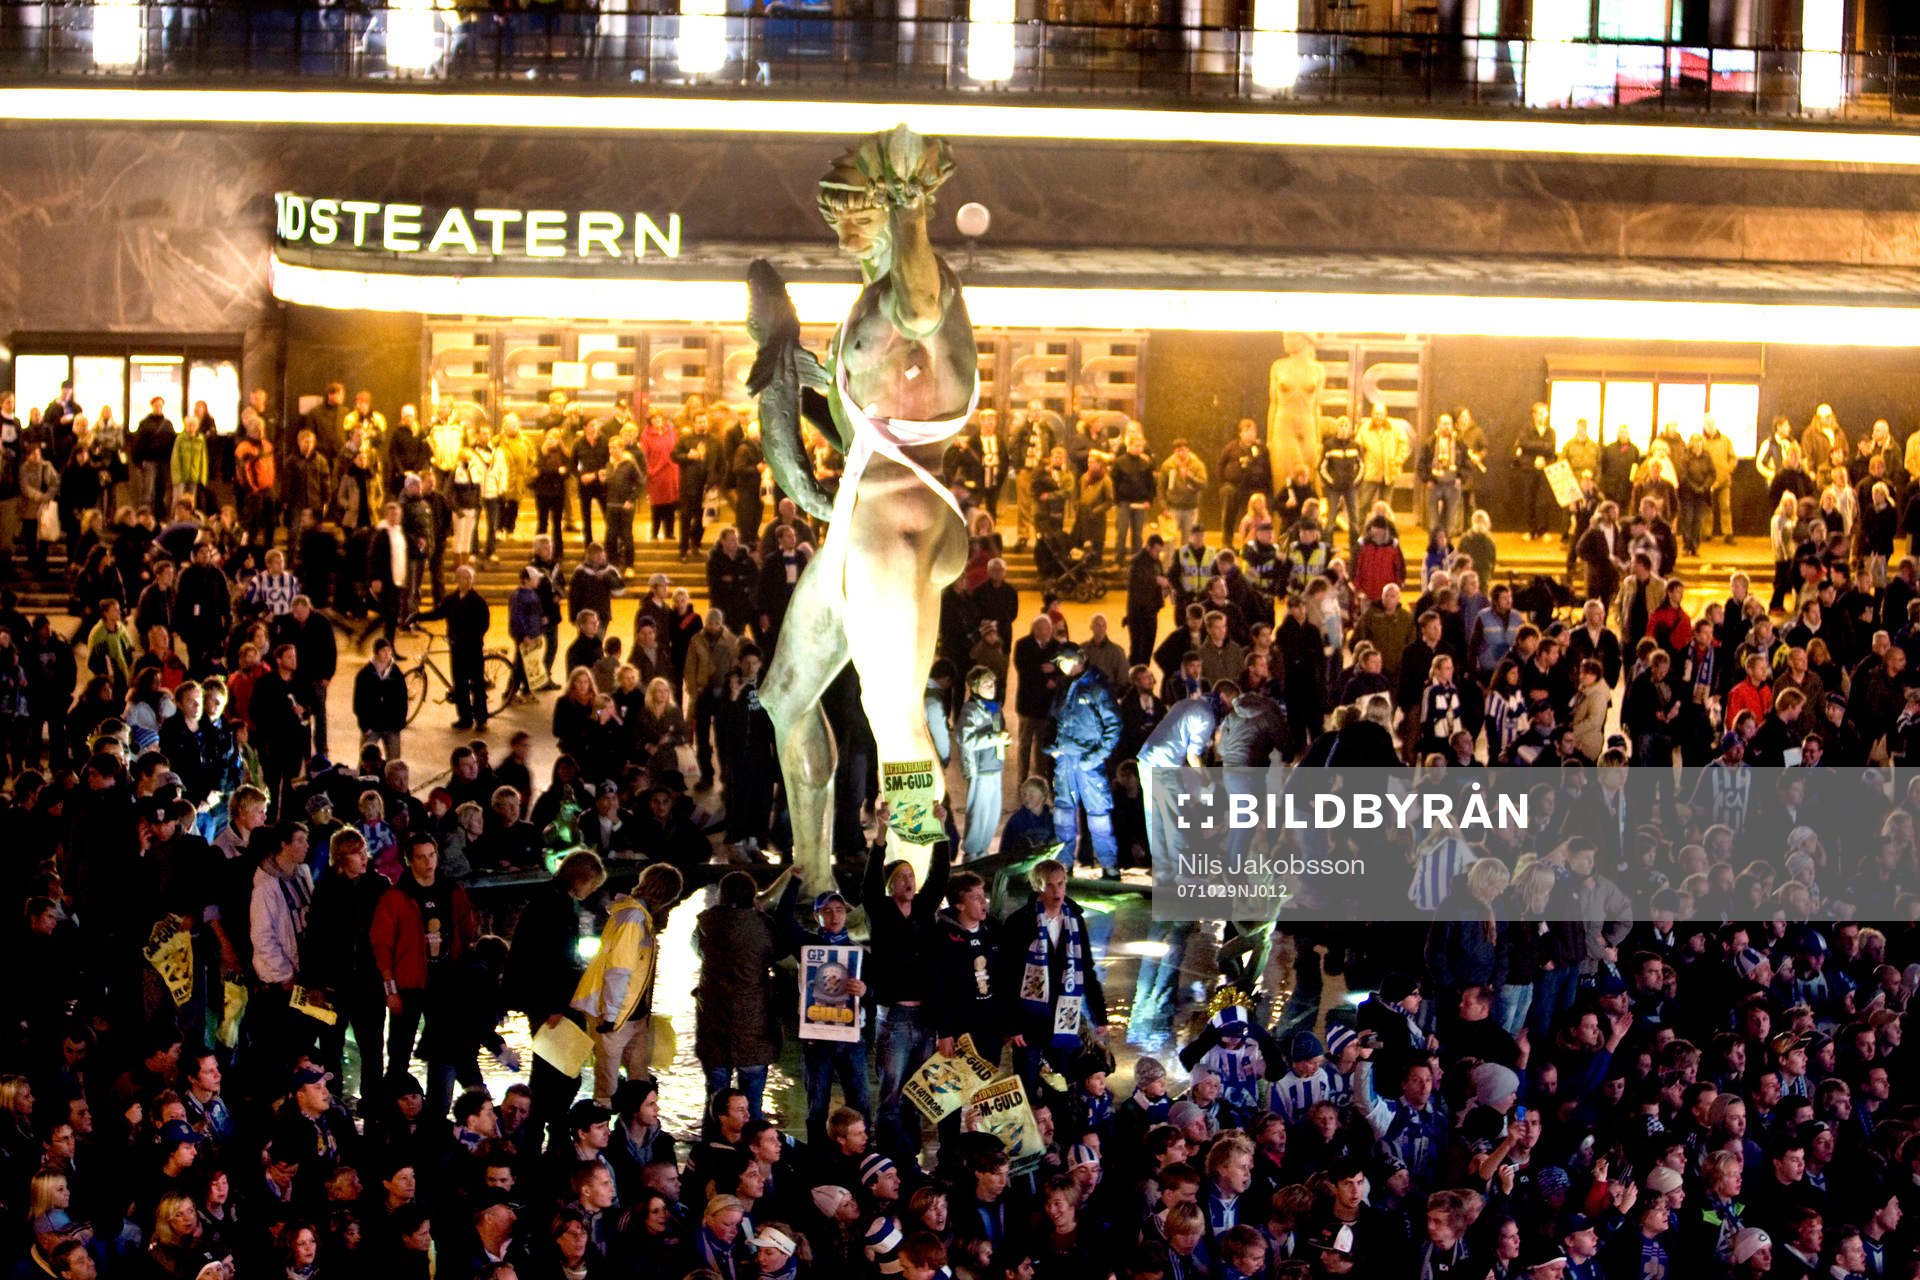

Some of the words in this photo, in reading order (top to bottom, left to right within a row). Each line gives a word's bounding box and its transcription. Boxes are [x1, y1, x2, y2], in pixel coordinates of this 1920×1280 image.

[885, 773, 933, 791] SM-GULD
[807, 949, 825, 961] GP
[807, 1005, 854, 1023] GULD
